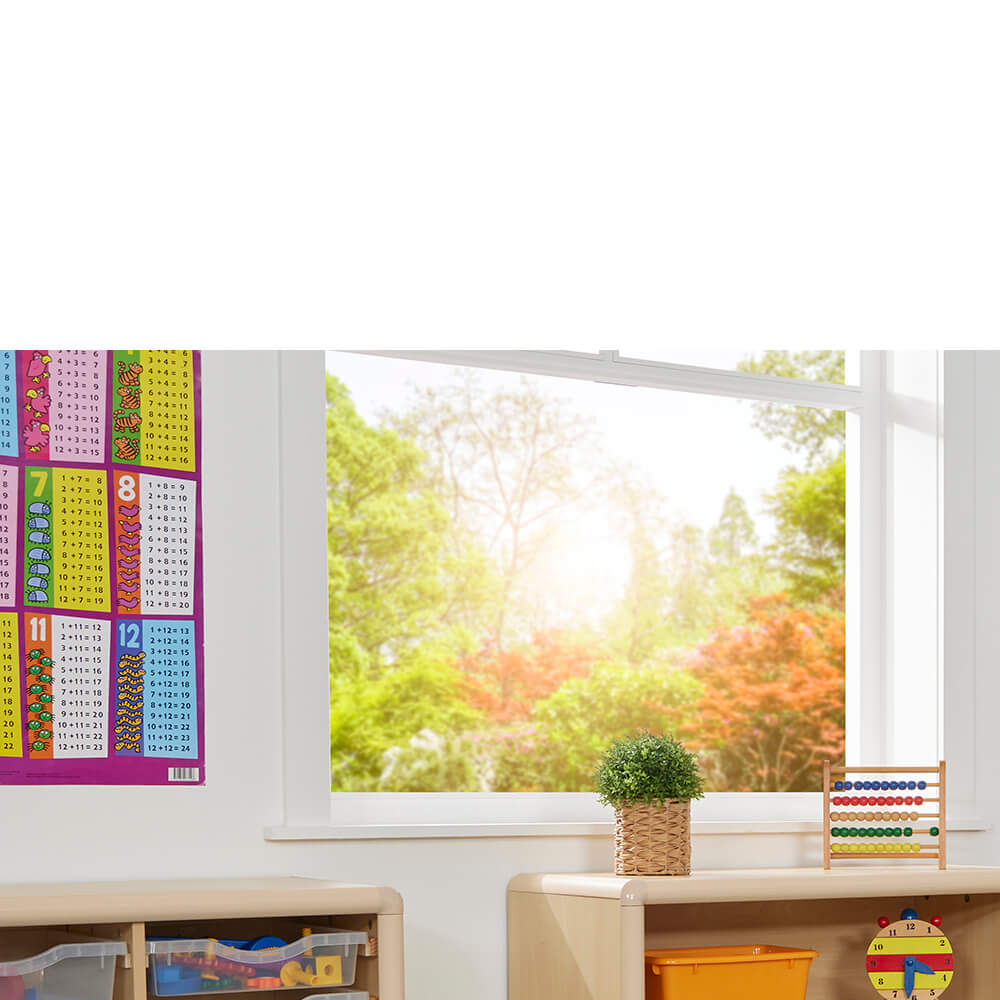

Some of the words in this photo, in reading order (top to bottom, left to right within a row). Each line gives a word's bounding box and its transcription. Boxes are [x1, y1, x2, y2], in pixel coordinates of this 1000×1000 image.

[30, 471, 48, 497] 7
[118, 475, 136, 501] 8
[30, 617, 46, 641] 11
[118, 623, 140, 648] 12
